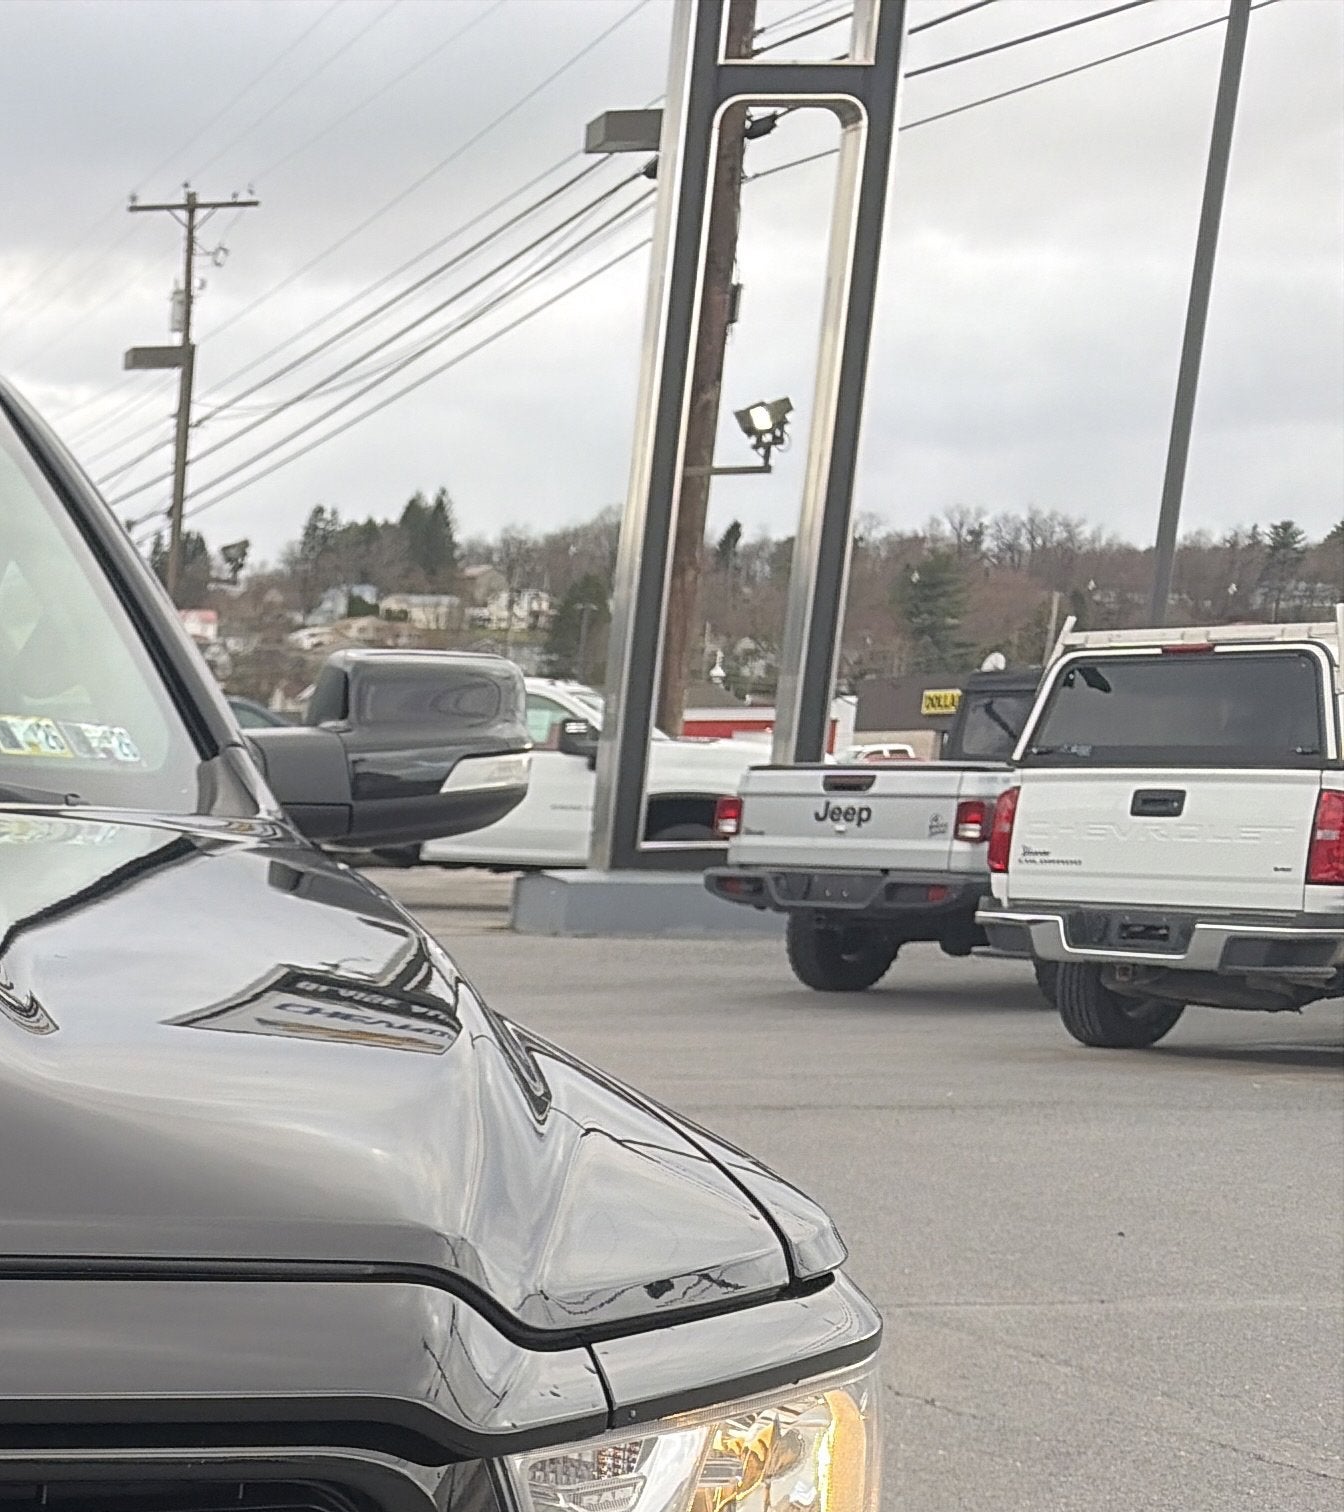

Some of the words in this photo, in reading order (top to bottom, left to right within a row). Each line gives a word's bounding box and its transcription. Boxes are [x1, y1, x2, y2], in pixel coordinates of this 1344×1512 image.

[925, 693, 961, 708] DOLL
[814, 800, 872, 827] Jeep
[1025, 820, 1296, 845] CHEVROLET
